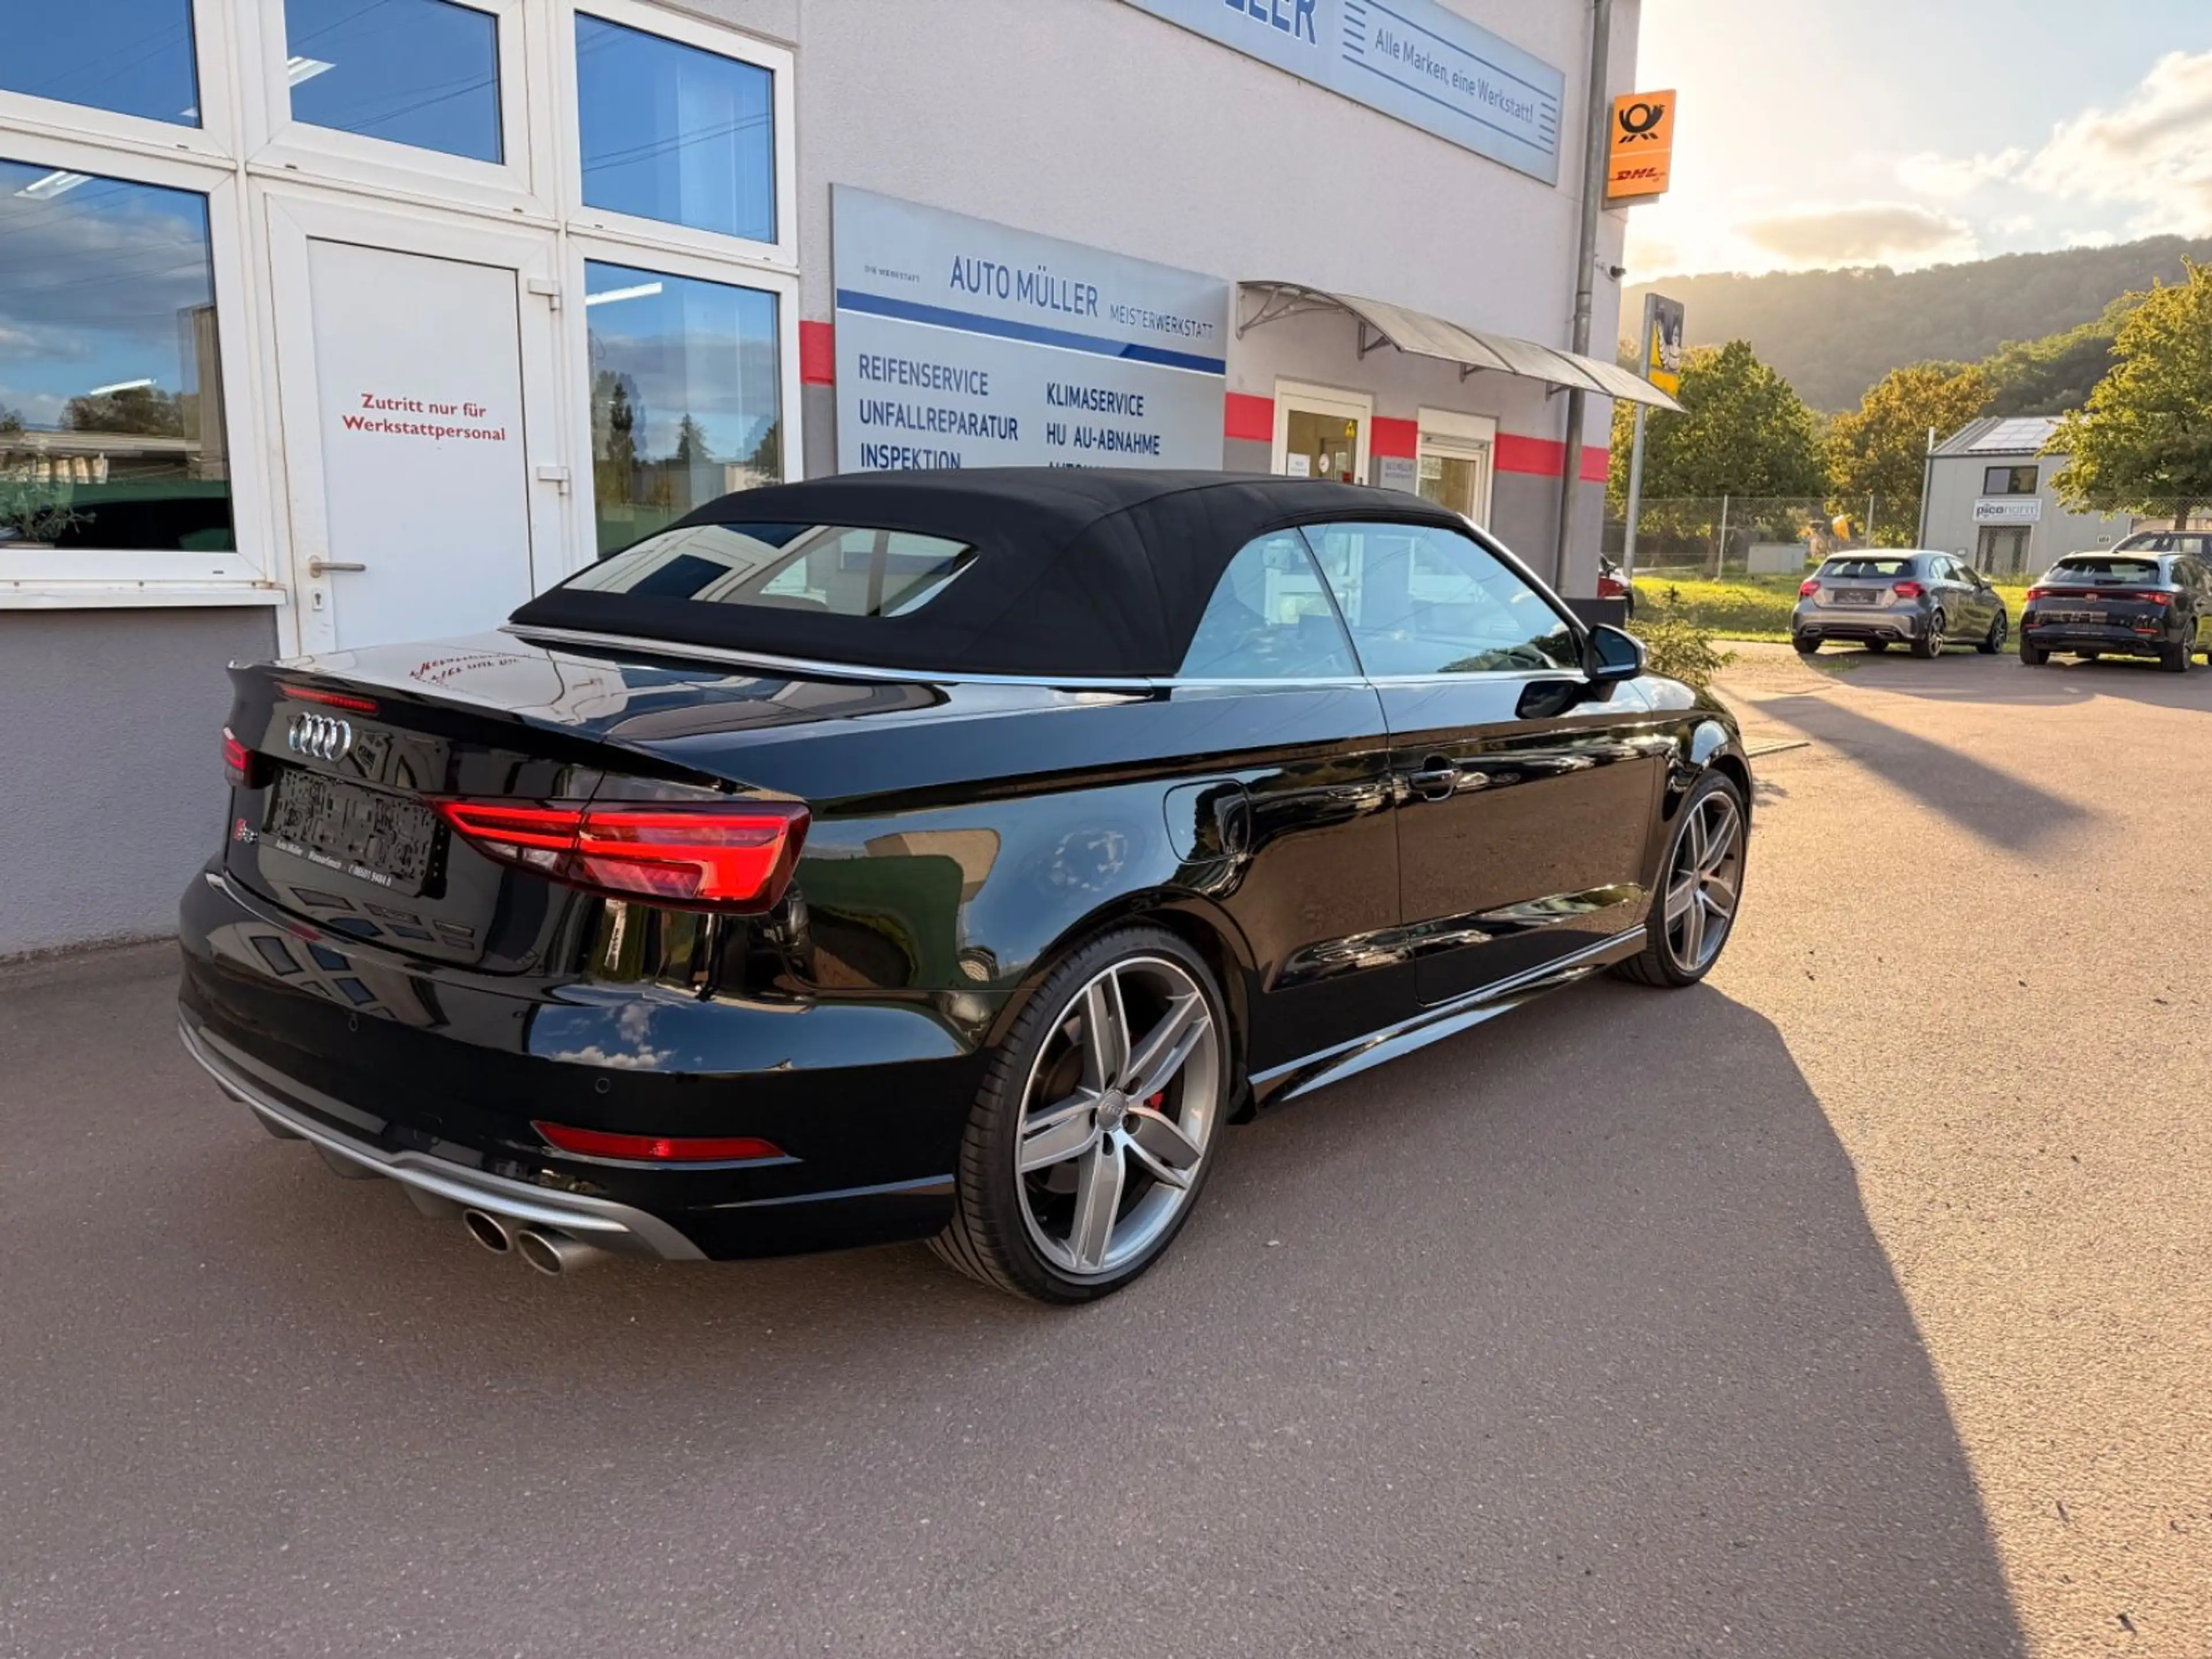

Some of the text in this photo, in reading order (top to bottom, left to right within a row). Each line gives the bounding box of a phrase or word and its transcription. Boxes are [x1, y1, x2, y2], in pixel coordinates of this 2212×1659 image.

[1376, 29, 1533, 124] Alle Marken, eine Werkstatt!
[1615, 167, 1657, 181] DHL
[950, 255, 1214, 339] AUTO MÜLLER MEISTERWERKSTATT
[859, 354, 988, 396] REIFENSERVICE
[361, 392, 487, 418] Zutritt nur für
[1047, 382, 1144, 416] KLIMASERVICE
[342, 415, 506, 441] Werkstattpersonal
[859, 399, 1018, 441] UNFALLREPARATUR
[1046, 422, 1160, 456] HU AU-ABNAHME
[861, 442, 960, 471] INSPEKTION
[1976, 503, 2036, 517] piconorm
